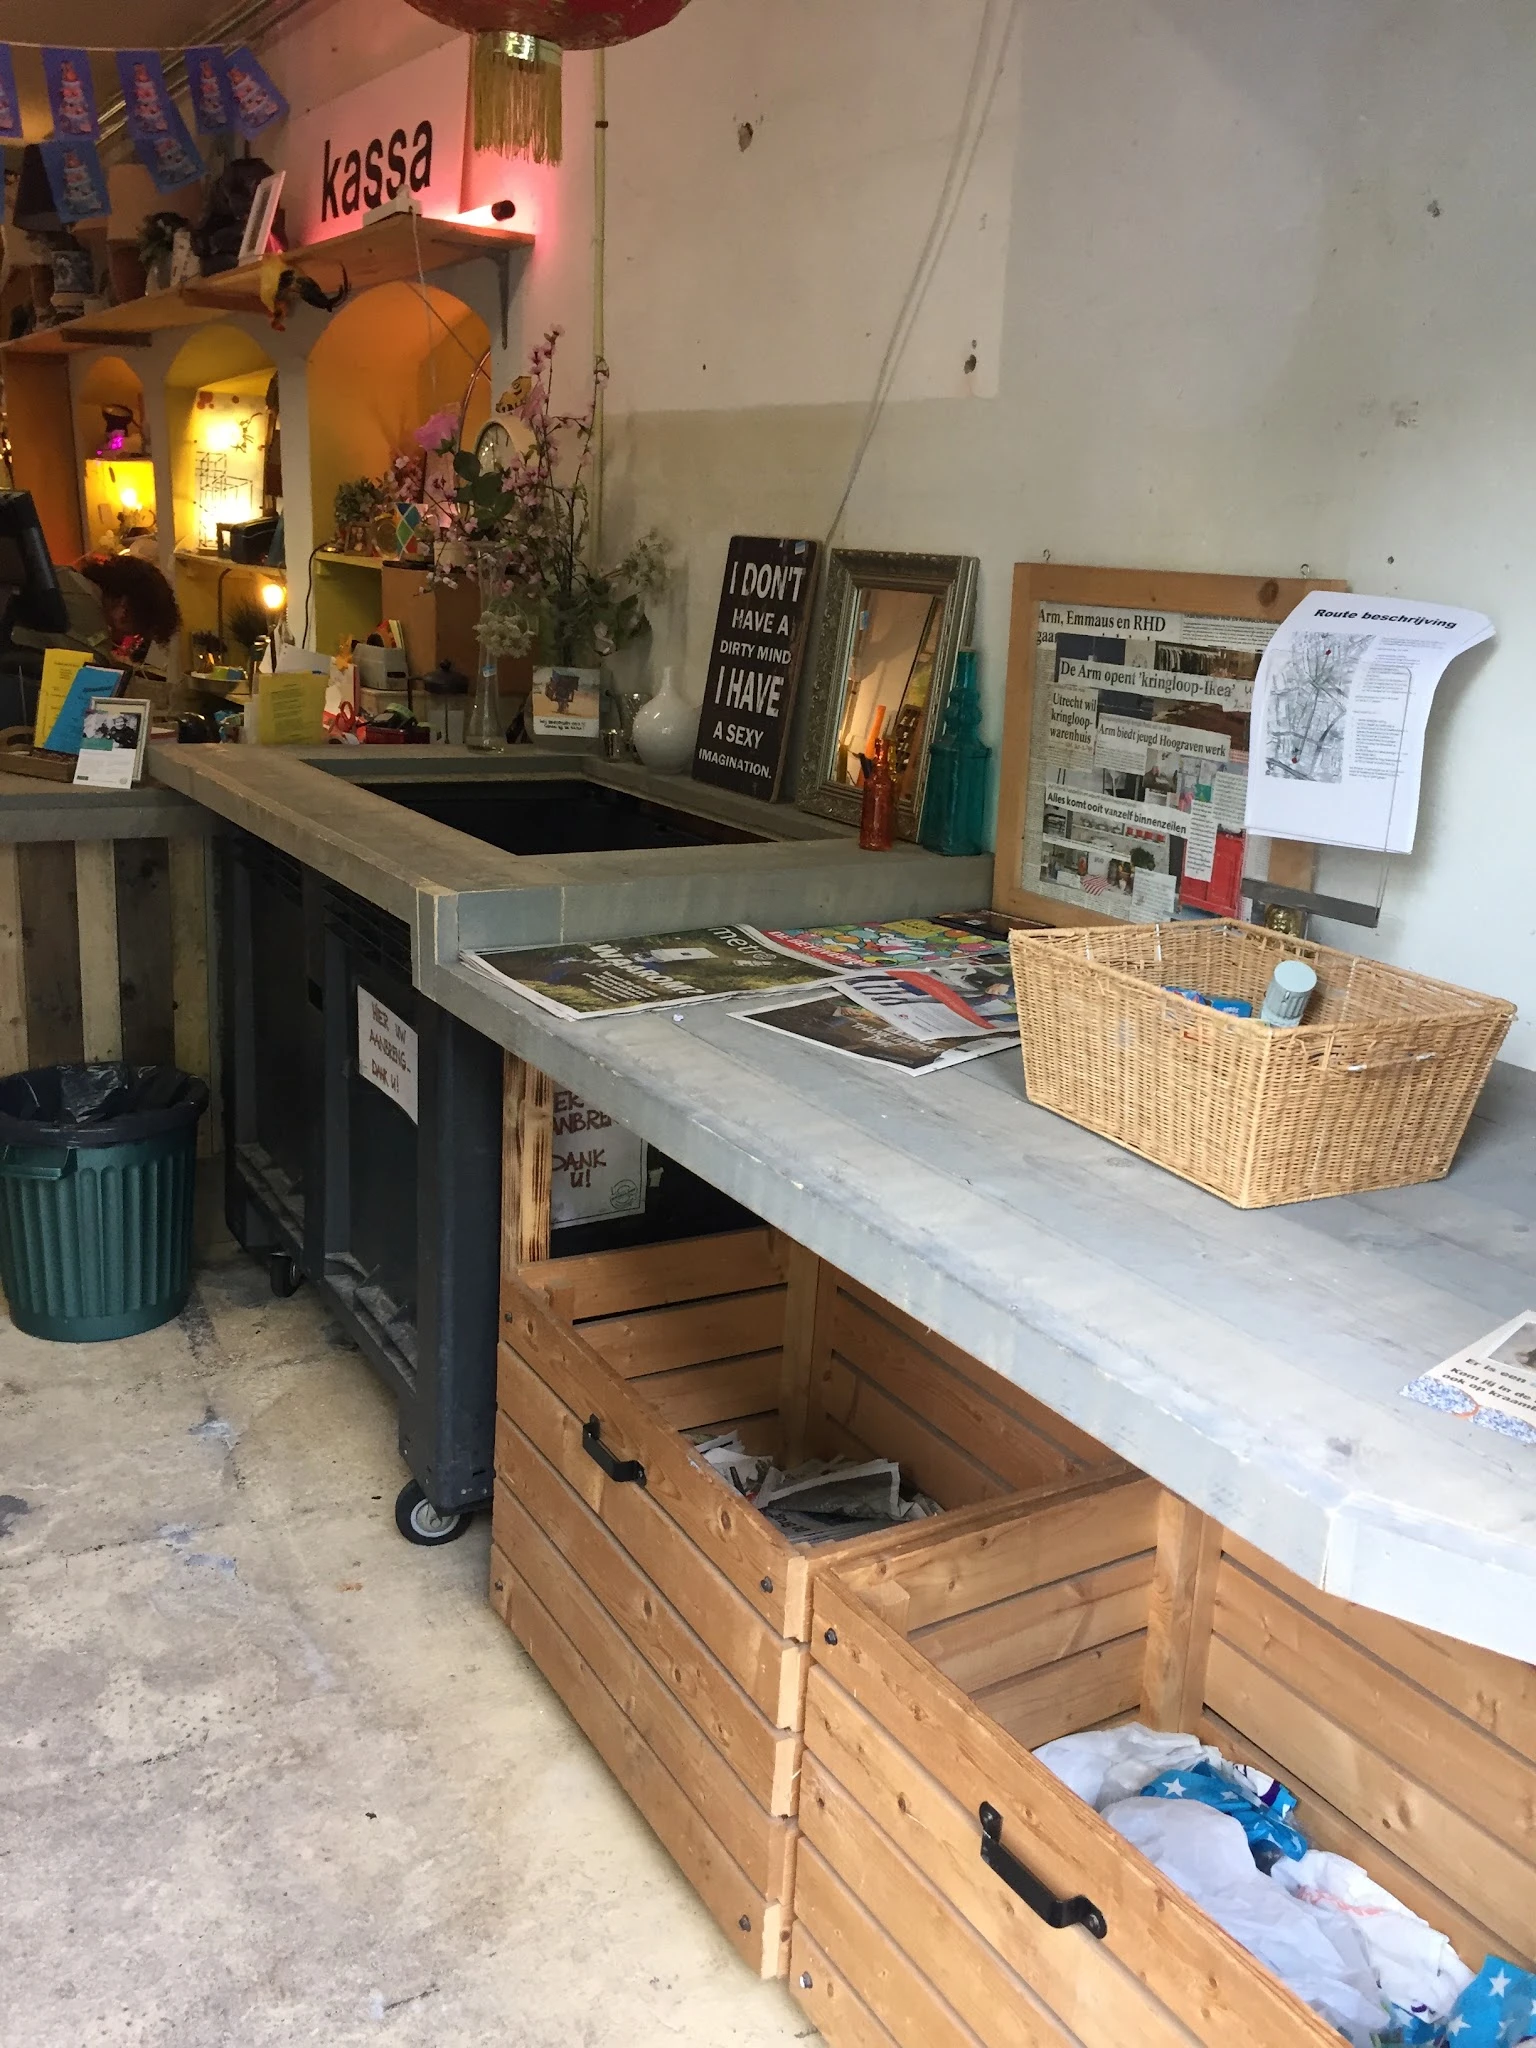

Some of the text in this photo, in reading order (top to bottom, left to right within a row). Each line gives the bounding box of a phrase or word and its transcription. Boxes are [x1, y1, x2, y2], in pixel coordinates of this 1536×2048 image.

[321, 120, 432, 222] kassa
[729, 561, 806, 602] I DON'T
[732, 608, 789, 636] HAVE A
[1038, 608, 1064, 626] Arm,
[1066, 610, 1114, 629] Emmaus
[1117, 617, 1130, 629] en
[1133, 614, 1166, 632] RHD
[1314, 609, 1457, 629] Route beschrijving
[720, 640, 792, 665] DIRTY MIND
[1060, 660, 1076, 676] De
[1078, 663, 1101, 681] Arm
[1104, 671, 1136, 687] opent
[715, 666, 785, 718] I HAVE
[1052, 692, 1097, 713] Utrecht wil
[1051, 708, 1093, 730] kringloop-
[713, 721, 764, 750] A SEXY
[1050, 727, 1092, 744] warenhuis
[1099, 724, 1116, 738] Arm
[1117, 727, 1135, 741] biedt
[1136, 731, 1159, 747] jeugd
[1160, 735, 1203, 754] Hoograven
[1205, 744, 1226, 757] werk
[698, 748, 772, 779] IMAGINATION.
[1048, 792, 1066, 805] Alles
[1066, 796, 1086, 810] komt
[1087, 800, 1103, 814] ooit
[1104, 807, 1133, 822] vanzelf
[1134, 813, 1187, 834] binnenzeilen
[590, 943, 706, 994] WAAROM?
[371, 1001, 407, 1045] HIER UW
[372, 1058, 400, 1094] DANK U!
[571, 1169, 591, 1188] U!
[1442, 1374, 1465, 1385] ook
[1469, 1382, 1486, 1392] op
[1450, 1367, 1480, 1381] Kom
[1498, 1385, 1512, 1393] in
[1514, 1391, 1532, 1400] de
[1465, 1358, 1527, 1383] Er is een
